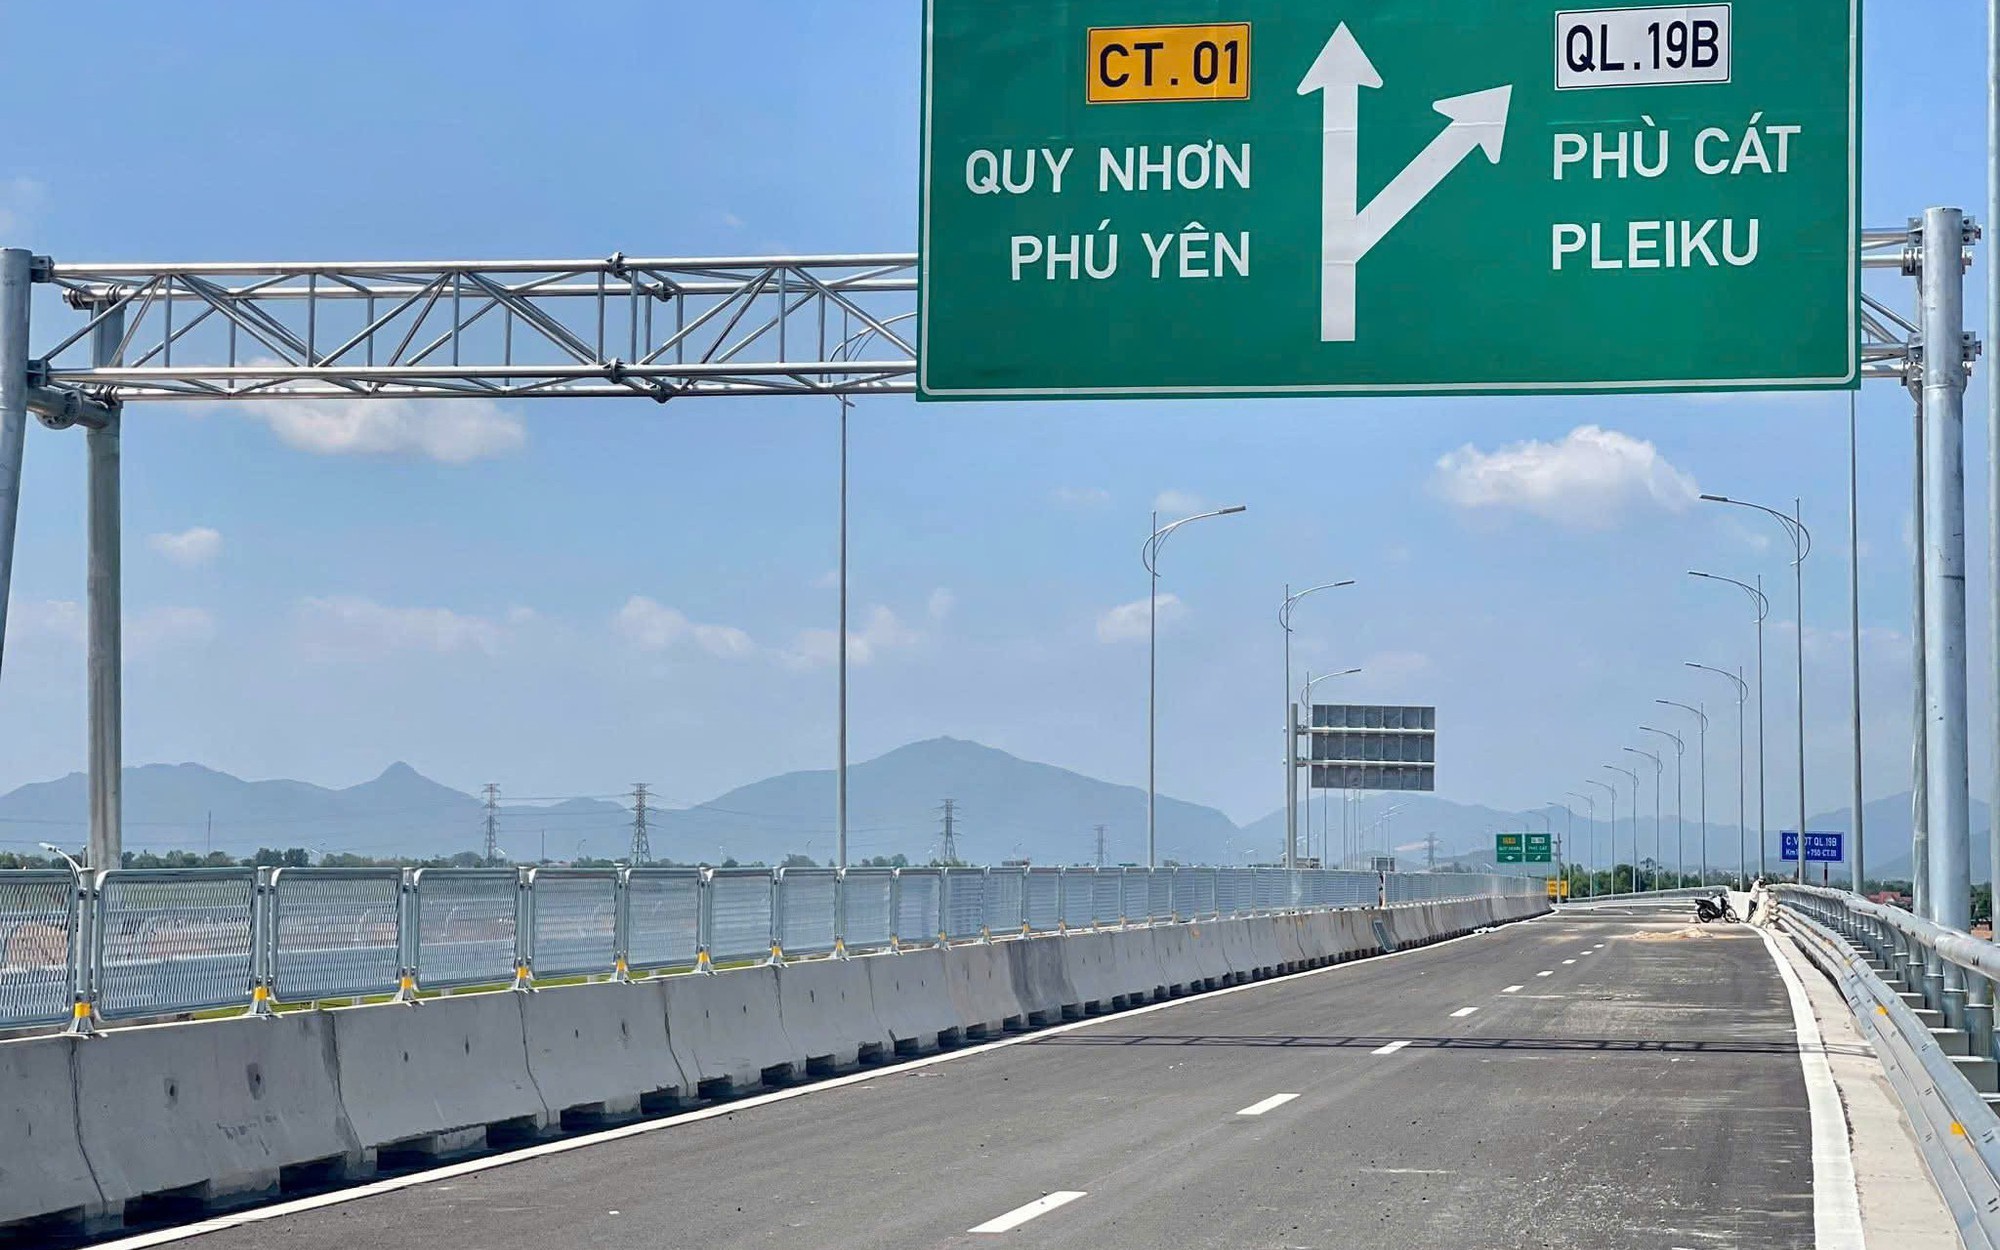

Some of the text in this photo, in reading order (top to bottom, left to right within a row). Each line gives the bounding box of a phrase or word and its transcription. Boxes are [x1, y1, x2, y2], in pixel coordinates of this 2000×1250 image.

[1099, 40, 1239, 88] CT.01
[1564, 19, 1720, 73] QL.19B
[965, 139, 1251, 195] QUY NHƠN
[1553, 111, 1802, 180] PHÙ CÁT
[1010, 218, 1250, 281] PHÚ YÊN
[1552, 218, 1760, 270] PLEIKU
